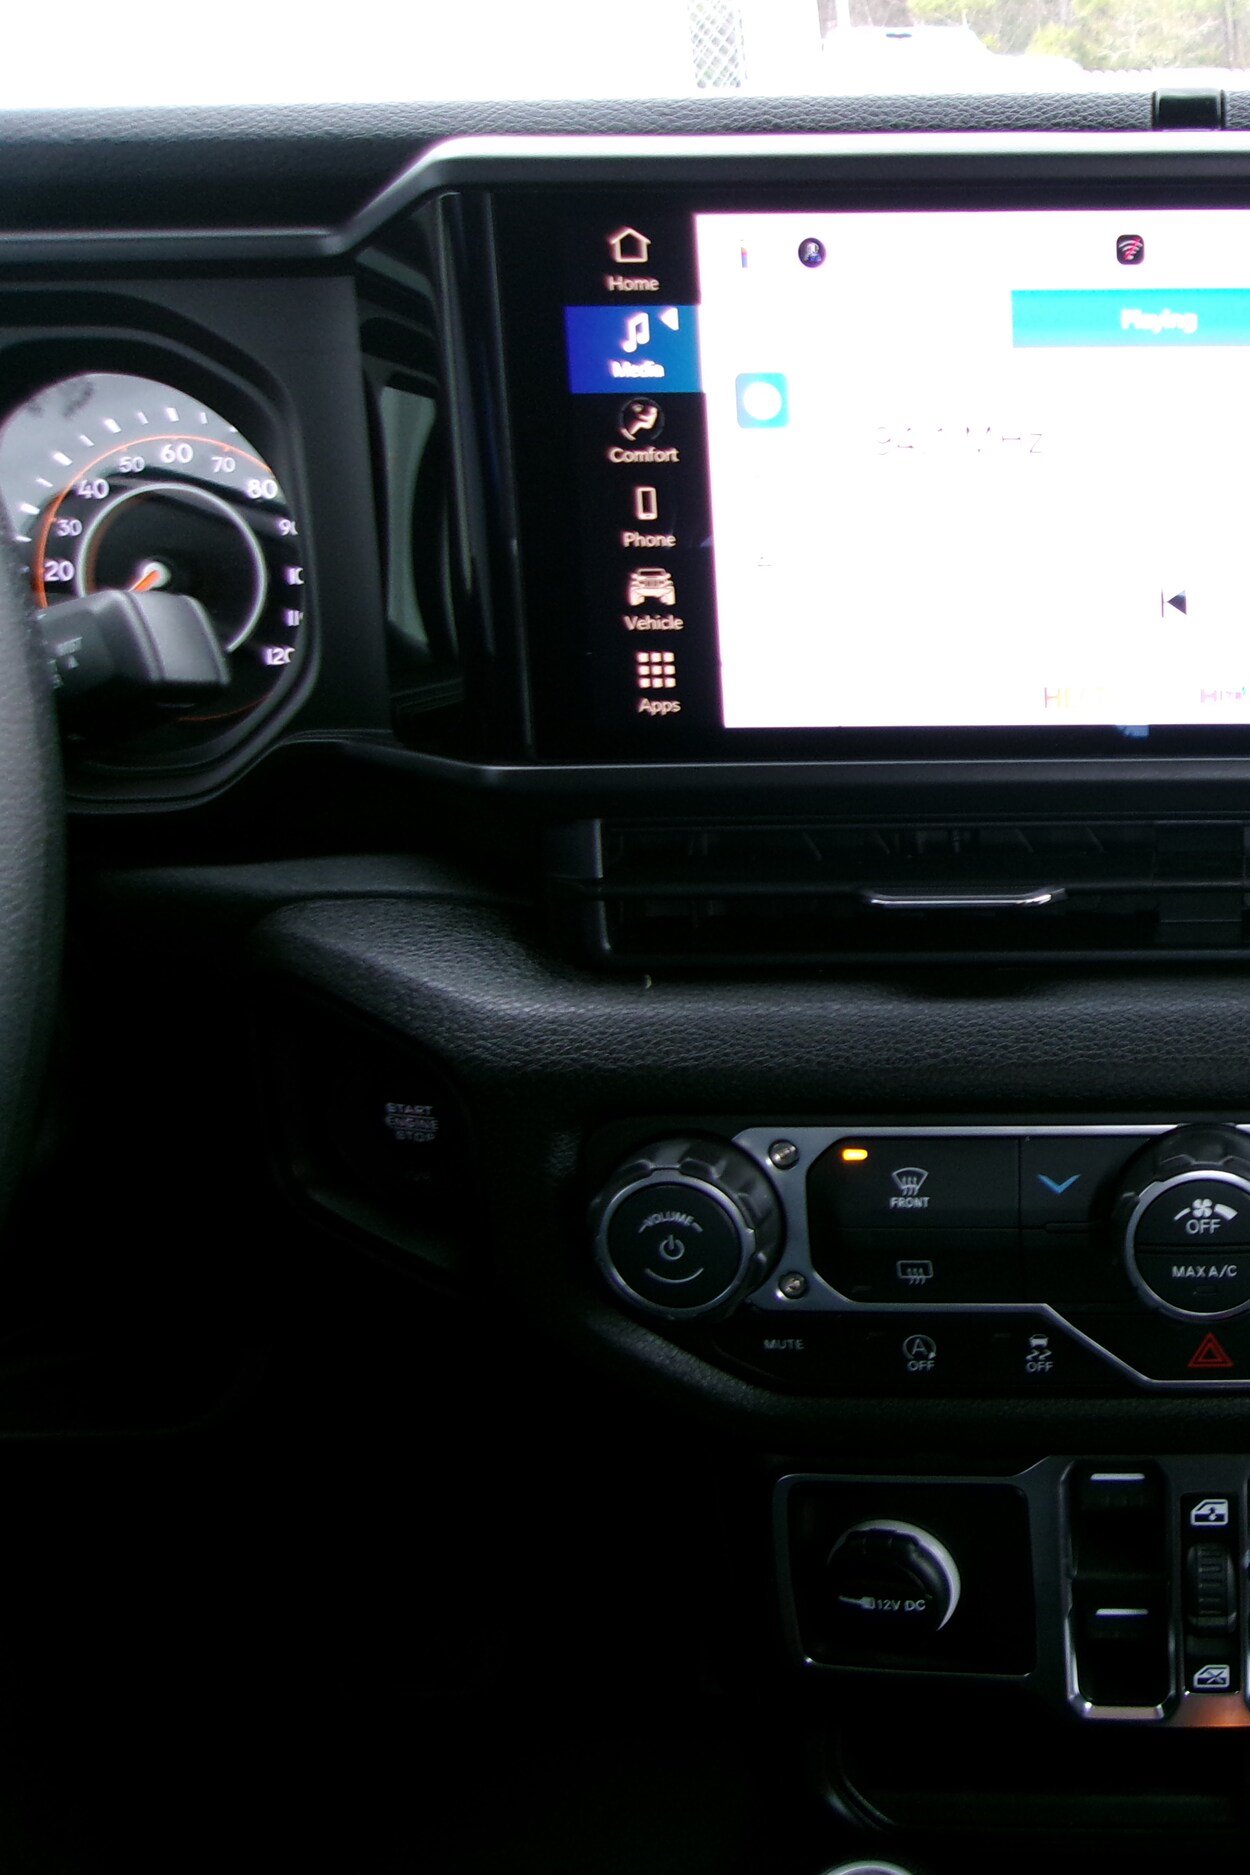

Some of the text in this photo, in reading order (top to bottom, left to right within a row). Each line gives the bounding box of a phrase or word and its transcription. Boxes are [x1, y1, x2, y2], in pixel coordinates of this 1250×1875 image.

[606, 275, 660, 291] Home
[1121, 308, 1198, 335] Playing
[610, 360, 665, 378] Media
[160, 443, 193, 463] 60
[609, 447, 680, 463] Comfort
[119, 456, 146, 472] 50
[211, 456, 236, 473] 70
[76, 479, 109, 499] 40
[247, 479, 279, 499] 80
[57, 519, 82, 537] 30
[622, 531, 676, 548] Phone
[45, 561, 74, 581] 20
[624, 614, 684, 631] Vehicle
[638, 698, 681, 716] Apps
[889, 1196, 931, 1210] FRONT
[1185, 1218, 1222, 1235] OFF
[1171, 1264, 1238, 1278] MAX A/C
[763, 1338, 804, 1351] MUTE
[907, 1359, 935, 1372] OFF
[1025, 1360, 1054, 1373] OFF
[877, 1599, 926, 1611] 12V DC
